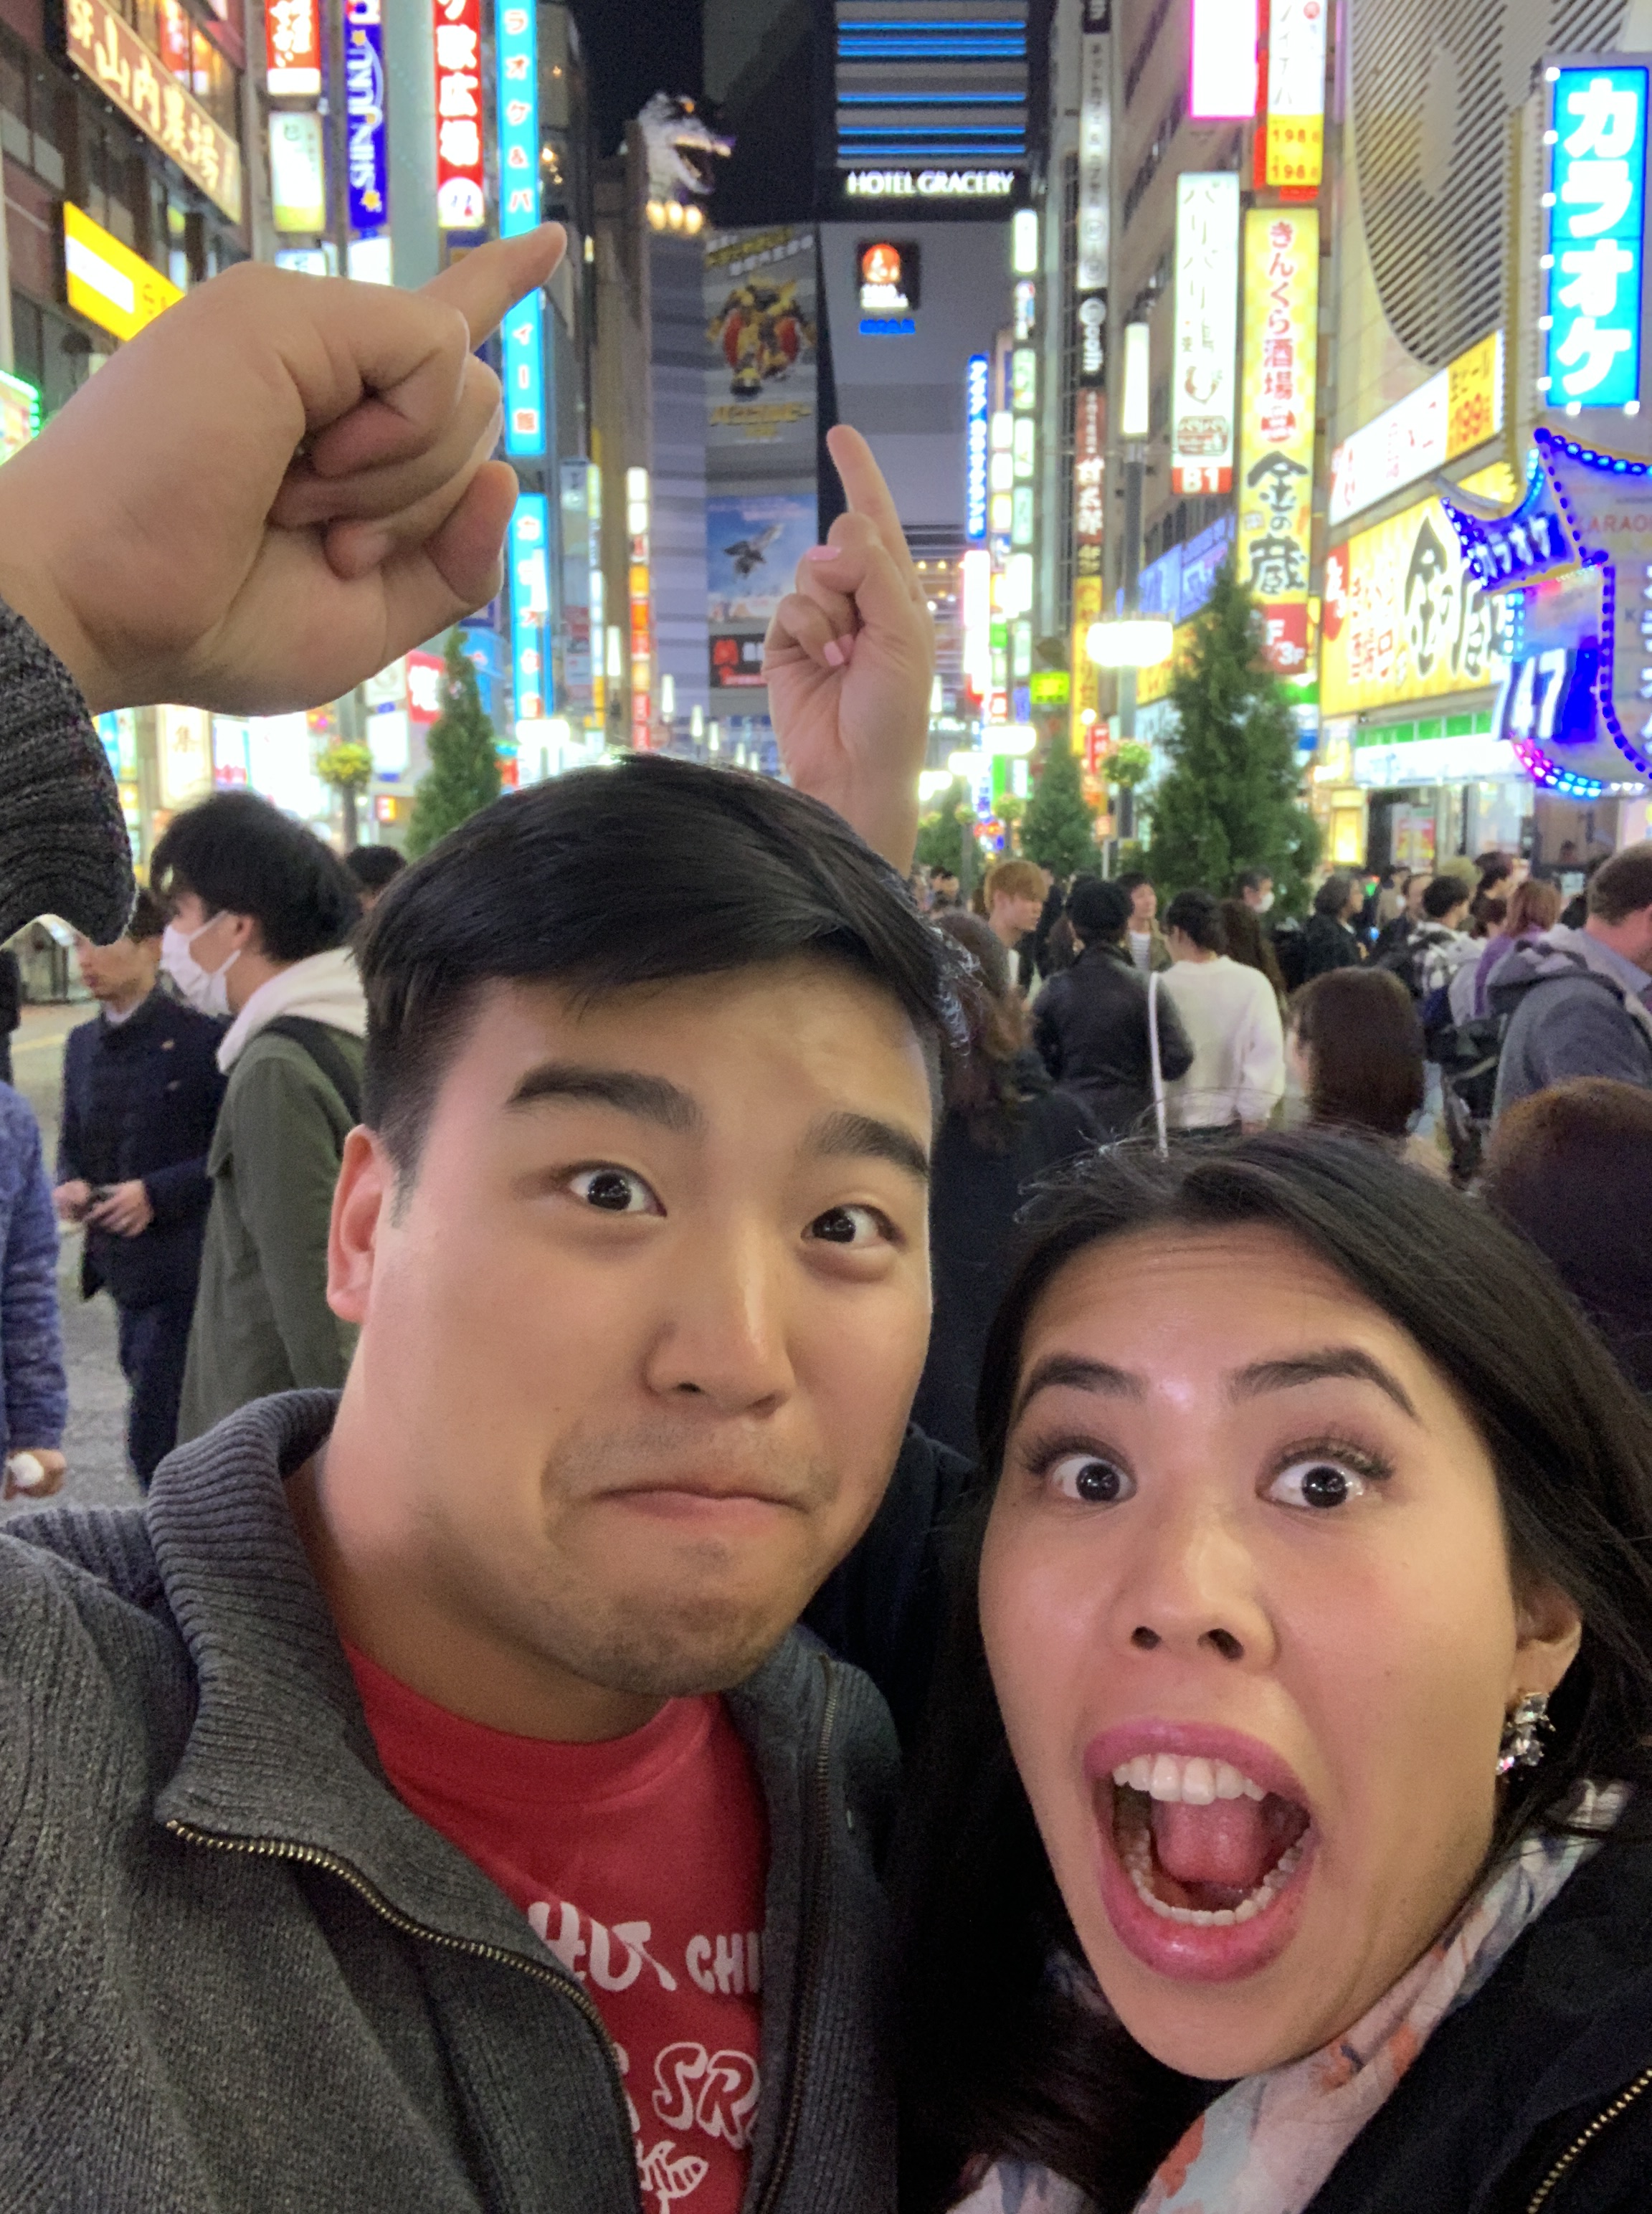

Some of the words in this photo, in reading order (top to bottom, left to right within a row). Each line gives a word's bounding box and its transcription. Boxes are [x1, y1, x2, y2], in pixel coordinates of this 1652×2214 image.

[848, 171, 916, 195] HOTEL
[917, 171, 1015, 195] GRACERY
[1556, 78, 1638, 396] カラオケ
[1263, 220, 1294, 401] きんくら酒場
[1182, 468, 1220, 493] B1
[1247, 450, 1309, 597] 金の蔵
[1491, 648, 1565, 741] 747
[652, 2040, 761, 2151] SR
